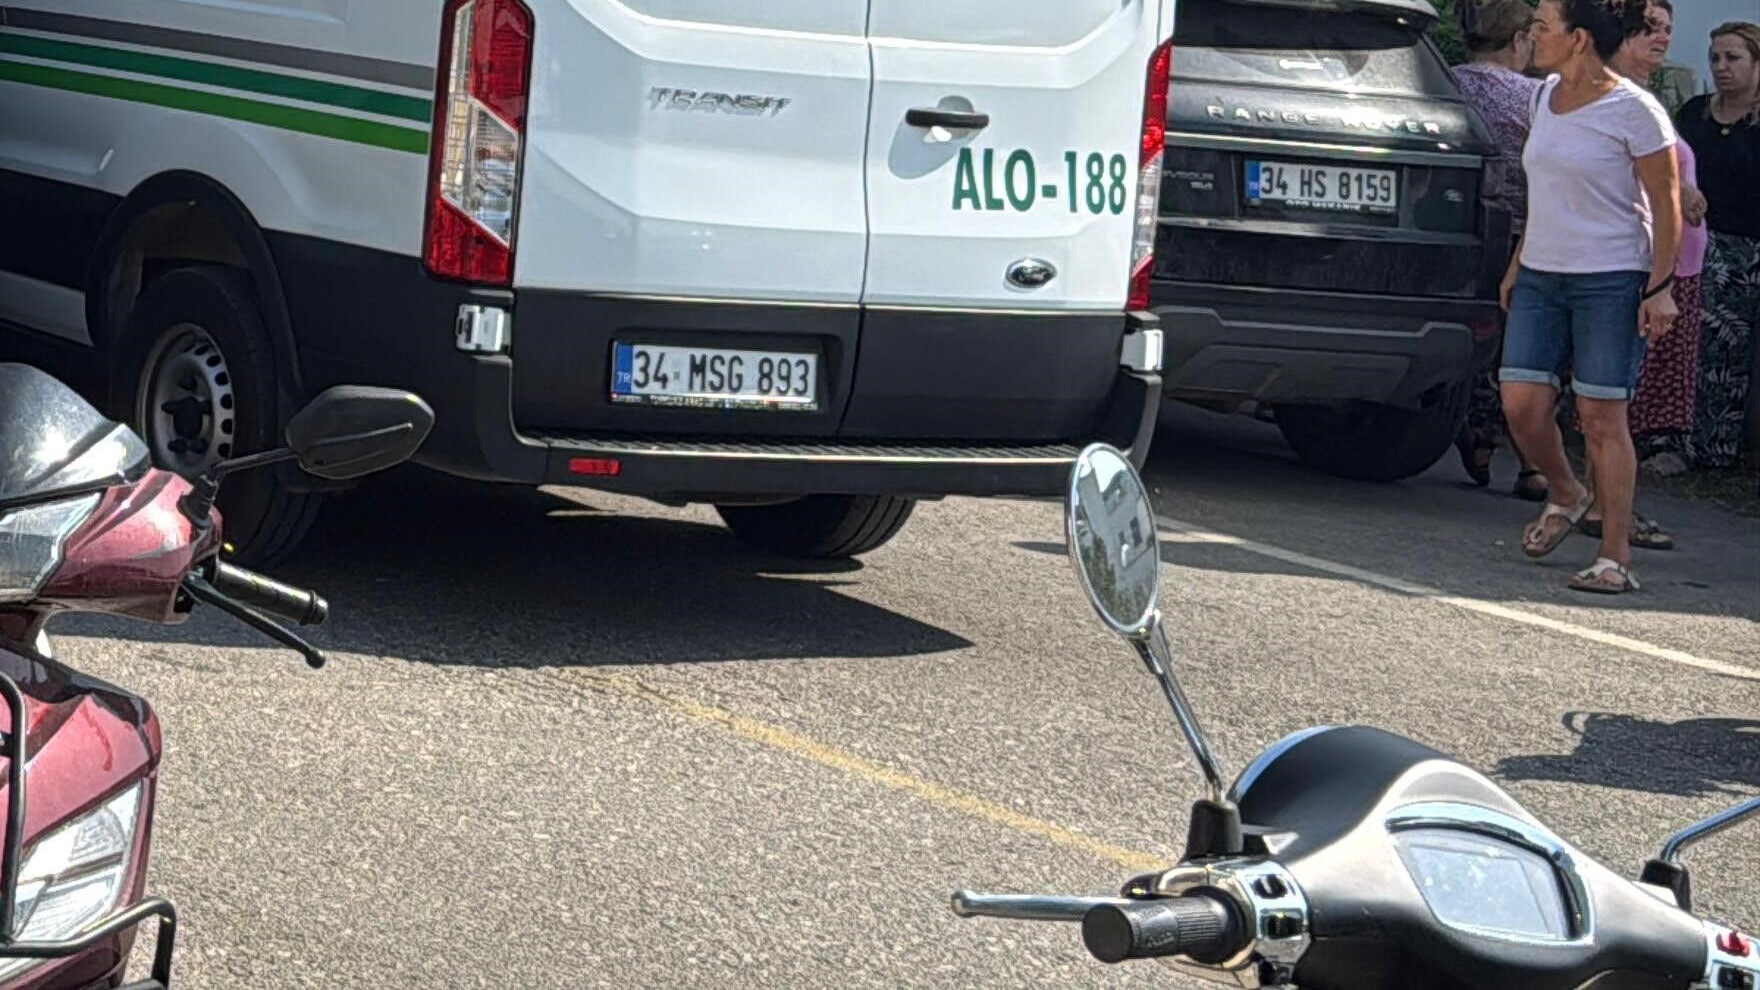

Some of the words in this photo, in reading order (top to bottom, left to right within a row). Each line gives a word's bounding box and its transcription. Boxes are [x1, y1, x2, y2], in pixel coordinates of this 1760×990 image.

[649, 86, 792, 112] TRANSIT
[1205, 104, 1321, 125] RANGE
[951, 146, 1127, 215] ALO-188
[1261, 166, 1288, 195] 34
[1300, 168, 1327, 198] HS
[1338, 171, 1391, 202] 8159
[616, 372, 631, 384] TR
[634, 350, 668, 389] 34
[689, 353, 743, 393] MSG
[758, 357, 810, 397] 893
